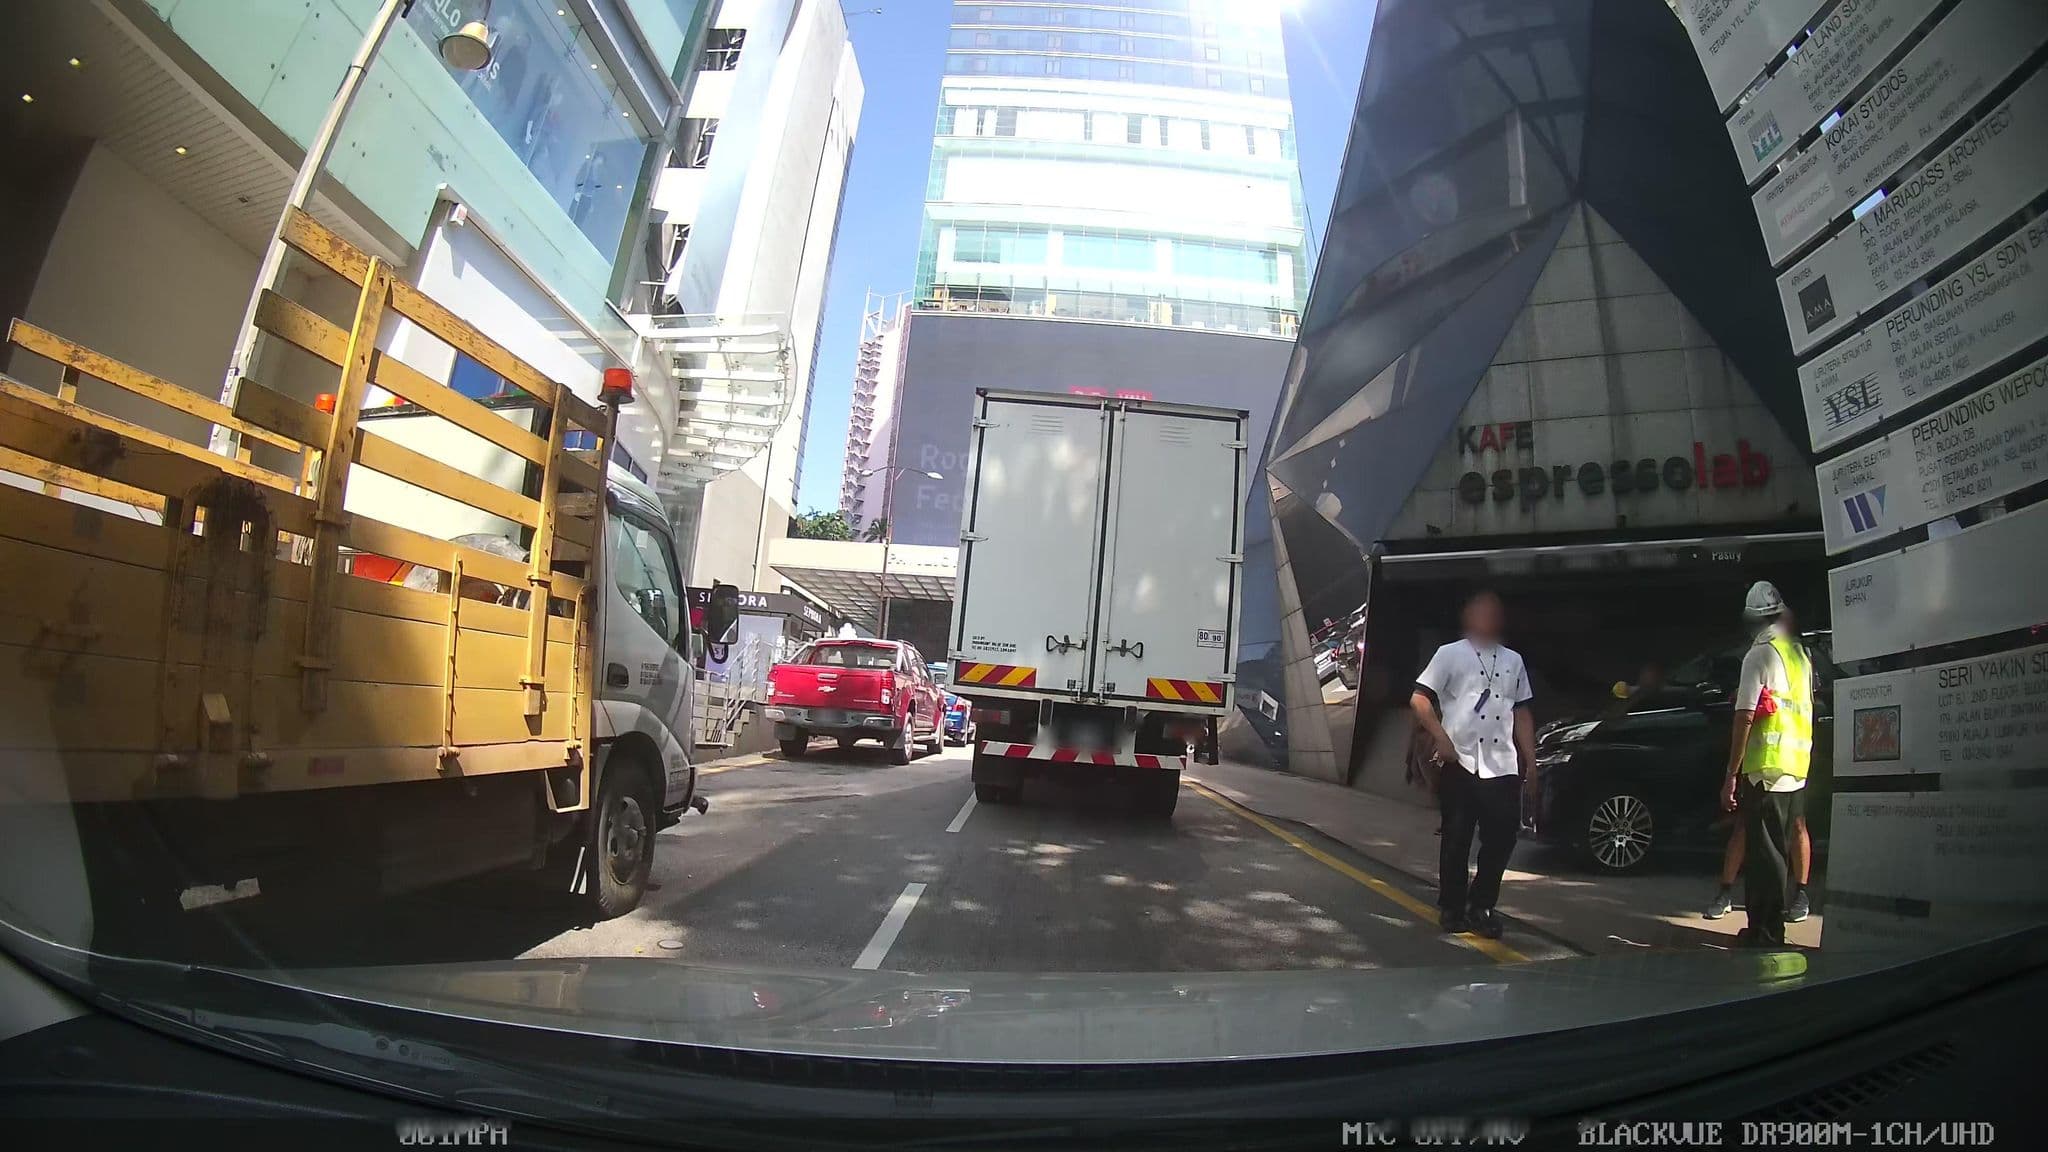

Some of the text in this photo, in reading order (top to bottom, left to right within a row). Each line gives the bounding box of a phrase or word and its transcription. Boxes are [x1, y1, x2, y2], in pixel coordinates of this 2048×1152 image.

[1792, 47, 1813, 69] YTL
[1813, 14, 1841, 49] LAND
[1824, 112, 1859, 151] KOKAI
[1859, 68, 1907, 119] STUDIOS
[1752, 125, 1779, 153] YTL
[1873, 162, 1944, 226] MARIADASS
[1806, 298, 1831, 320] AMA
[1885, 278, 1963, 337] PERUNDING
[1965, 261, 1994, 287] YSL
[1995, 240, 2027, 269] SDN
[1823, 372, 1879, 430] YSL
[1911, 392, 1995, 445] PERUNDING
[1458, 421, 1534, 455] KAFE
[1458, 439, 1772, 513] espressolab
[1938, 665, 1973, 688] SERI
[1979, 657, 2025, 680] YAKIN
